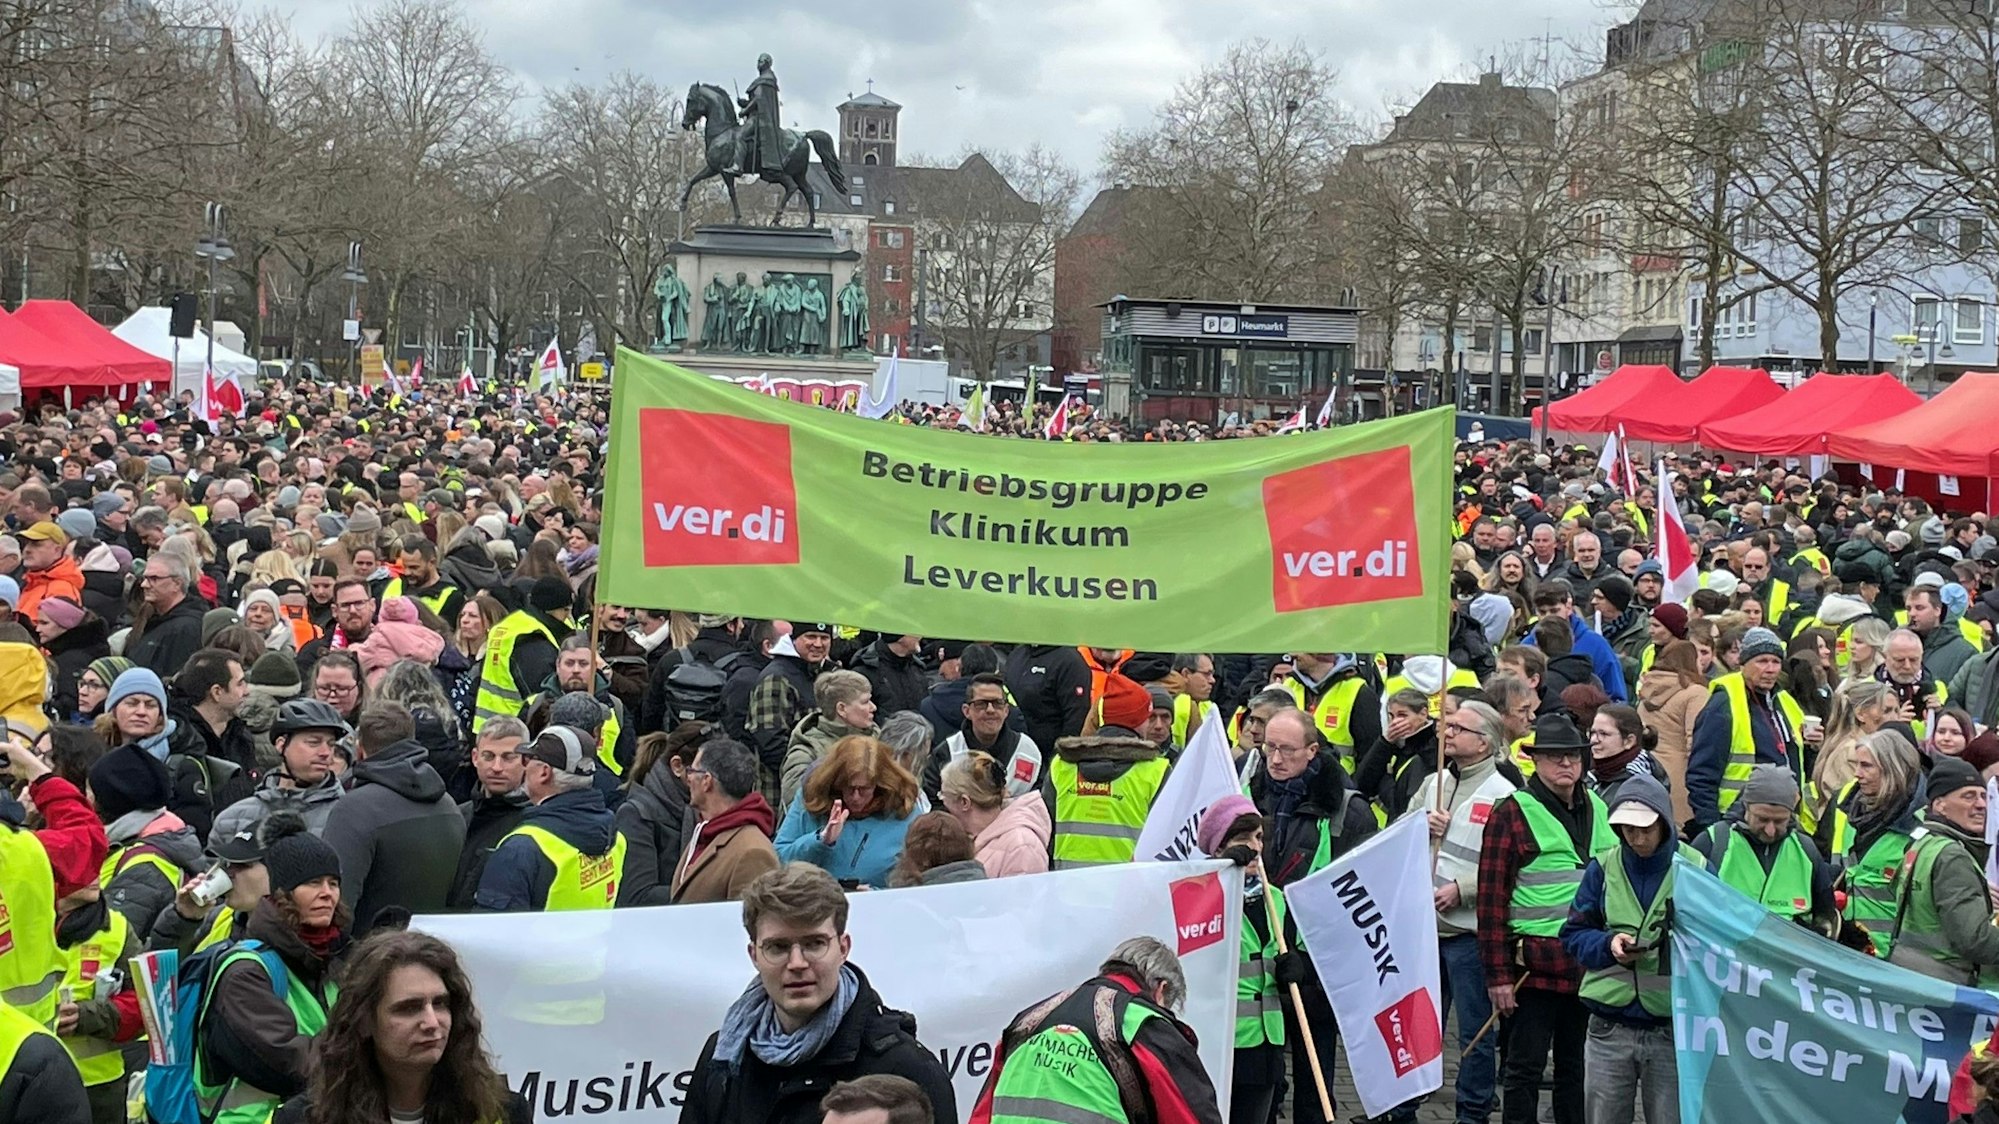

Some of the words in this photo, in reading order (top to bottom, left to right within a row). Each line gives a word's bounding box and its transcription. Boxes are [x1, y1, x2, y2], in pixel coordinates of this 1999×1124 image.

[1241, 321, 1284, 331] Heumarkt
[862, 450, 1209, 509] Betriebsgruppe
[653, 502, 785, 543] ver.di
[930, 509, 1129, 547] Klinikum
[904, 554, 1158, 600] Leverkusen
[1282, 540, 1408, 578] ver.di
[1330, 869, 1400, 987] MUSIK
[1791, 967, 1945, 1042] faire
[1676, 998, 1730, 1056] in
[1745, 1020, 1863, 1082] der
